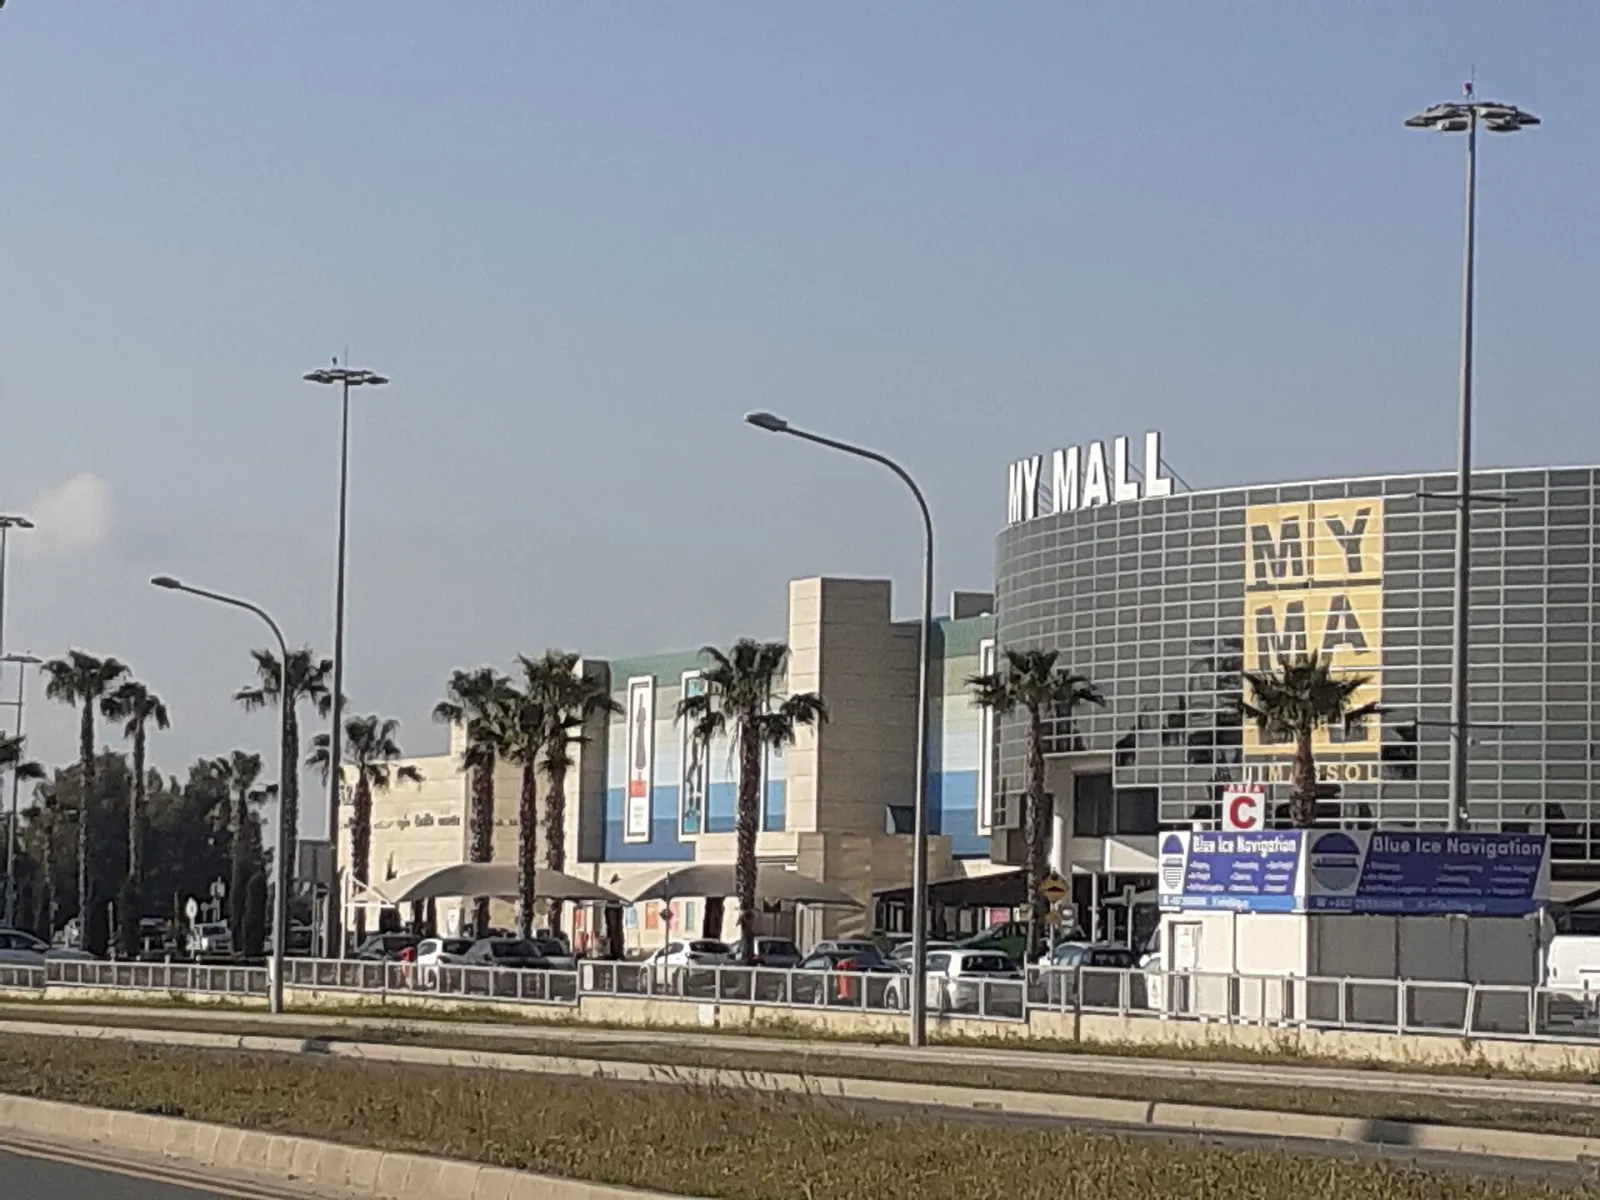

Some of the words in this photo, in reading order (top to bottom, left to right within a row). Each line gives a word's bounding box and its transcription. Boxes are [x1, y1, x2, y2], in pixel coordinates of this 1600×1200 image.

[1008, 454, 1042, 526] MY
[1052, 431, 1174, 514] MALL
[1250, 507, 1371, 585] MY
[1229, 796, 1257, 829] C
[1372, 836, 1410, 853] Blue
[1416, 837, 1442, 854] Ice
[1447, 838, 1542, 859] Navigation
